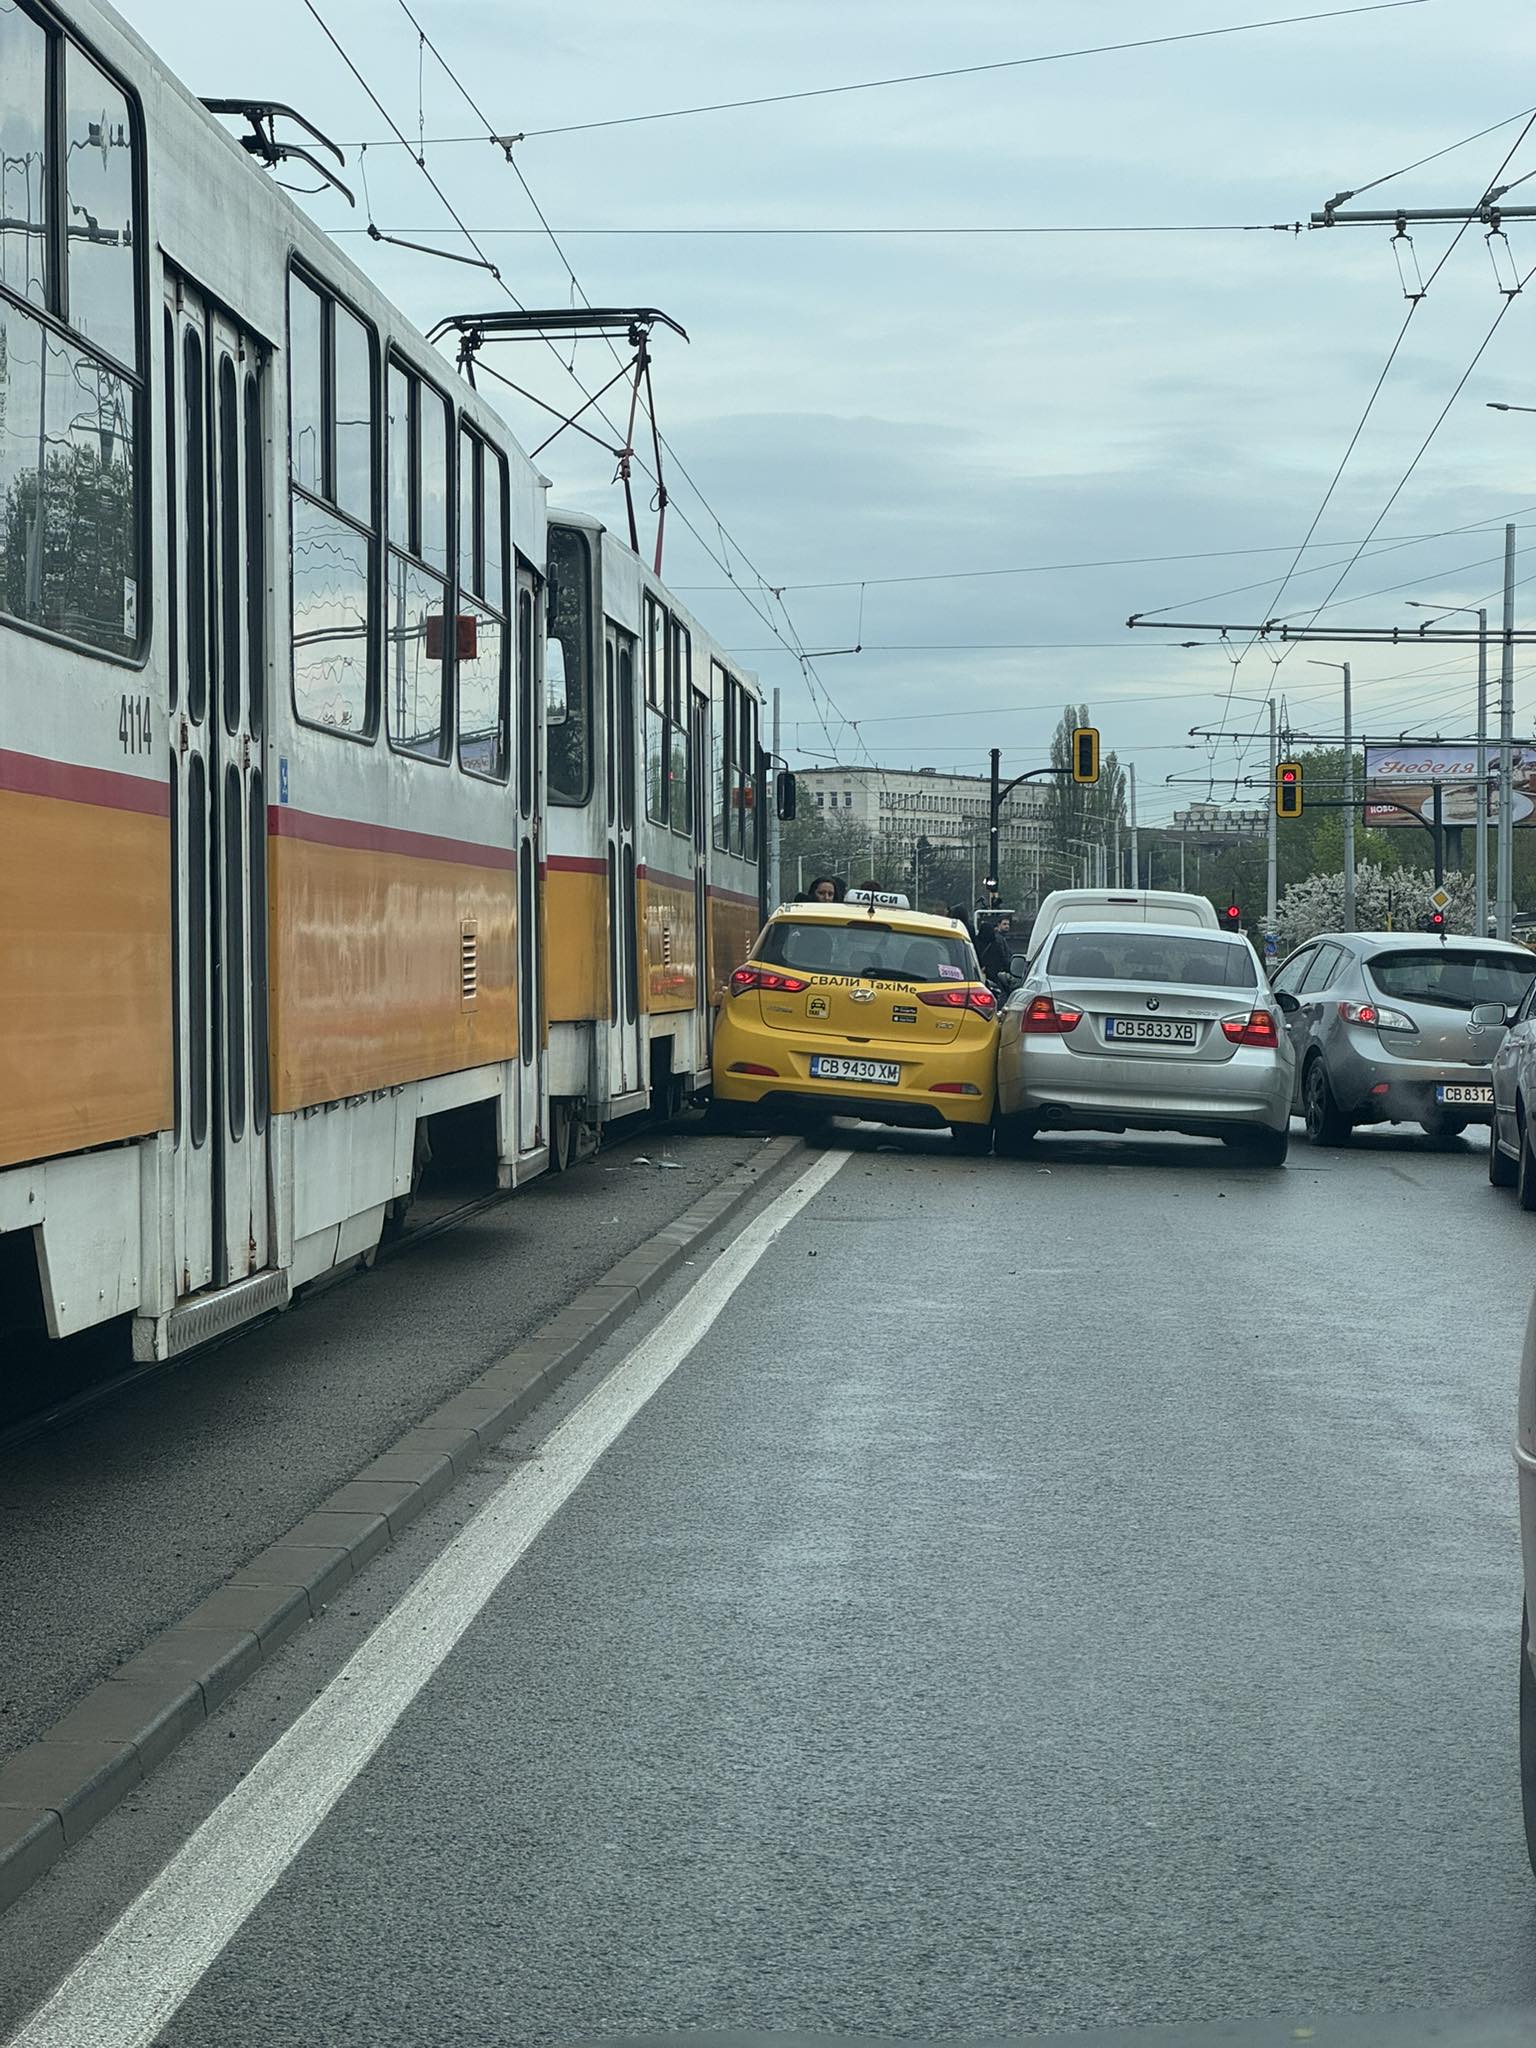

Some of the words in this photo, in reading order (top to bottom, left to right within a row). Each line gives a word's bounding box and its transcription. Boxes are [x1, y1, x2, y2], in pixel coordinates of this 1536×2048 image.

[119, 694, 152, 755] 4114
[1378, 760, 1475, 774] Неделя
[855, 891, 899, 905] ТАКСИ
[810, 976, 860, 987] СВАЛИ
[869, 980, 917, 994] TaxiMe
[1137, 1022, 1172, 1038] 5833
[842, 1061, 876, 1078] 9430
[1464, 1088, 1494, 1101] 8312
